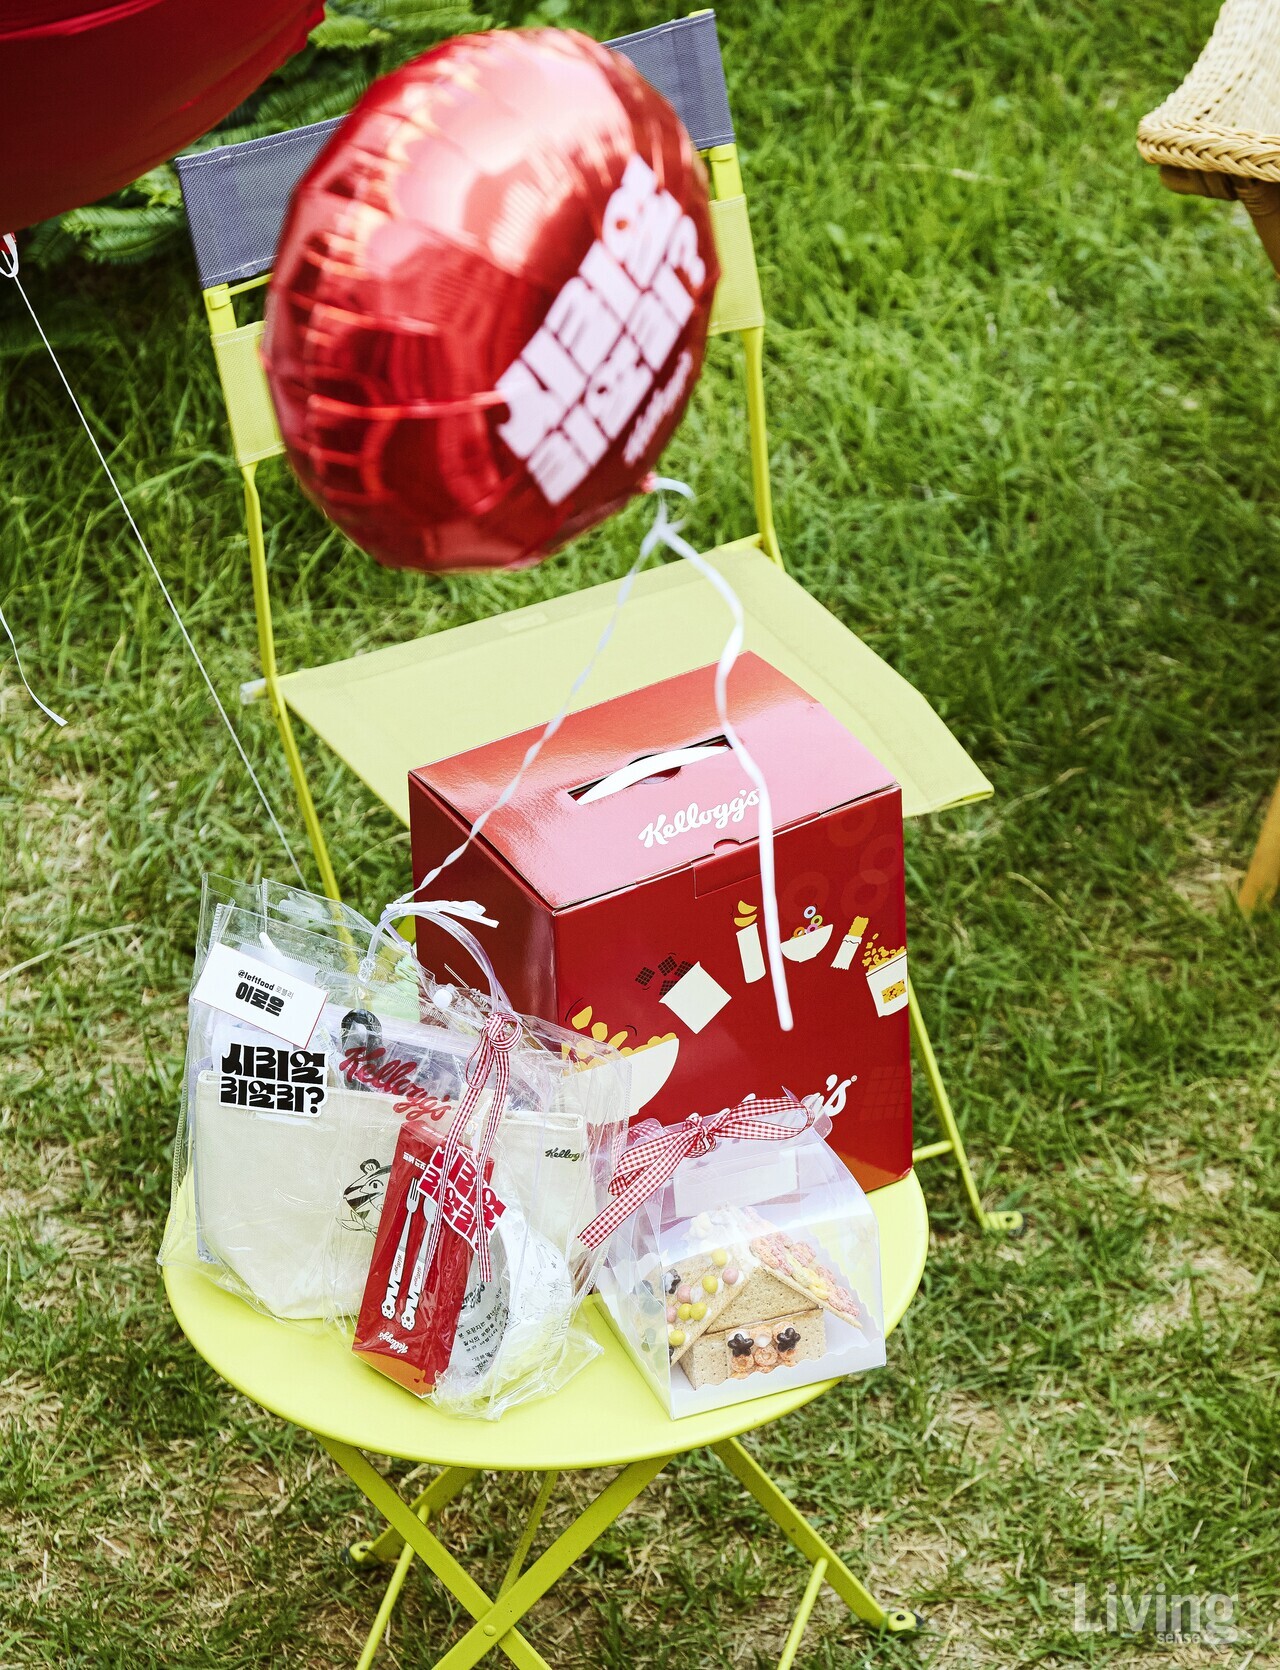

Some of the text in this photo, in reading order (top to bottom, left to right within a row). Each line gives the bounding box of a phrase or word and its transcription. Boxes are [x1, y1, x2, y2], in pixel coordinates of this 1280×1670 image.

[494, 151, 683, 460] 시리얼
[527, 213, 706, 505] 리얼리?
[638, 788, 761, 848] Kellogg's
[237, 969, 275, 991] @leftfood
[221, 1043, 325, 1085] 시리얼
[339, 1046, 452, 1121] Kellogg's
[220, 1076, 325, 1114] 리얼리?
[377, 1331, 409, 1354] Kellogg's
